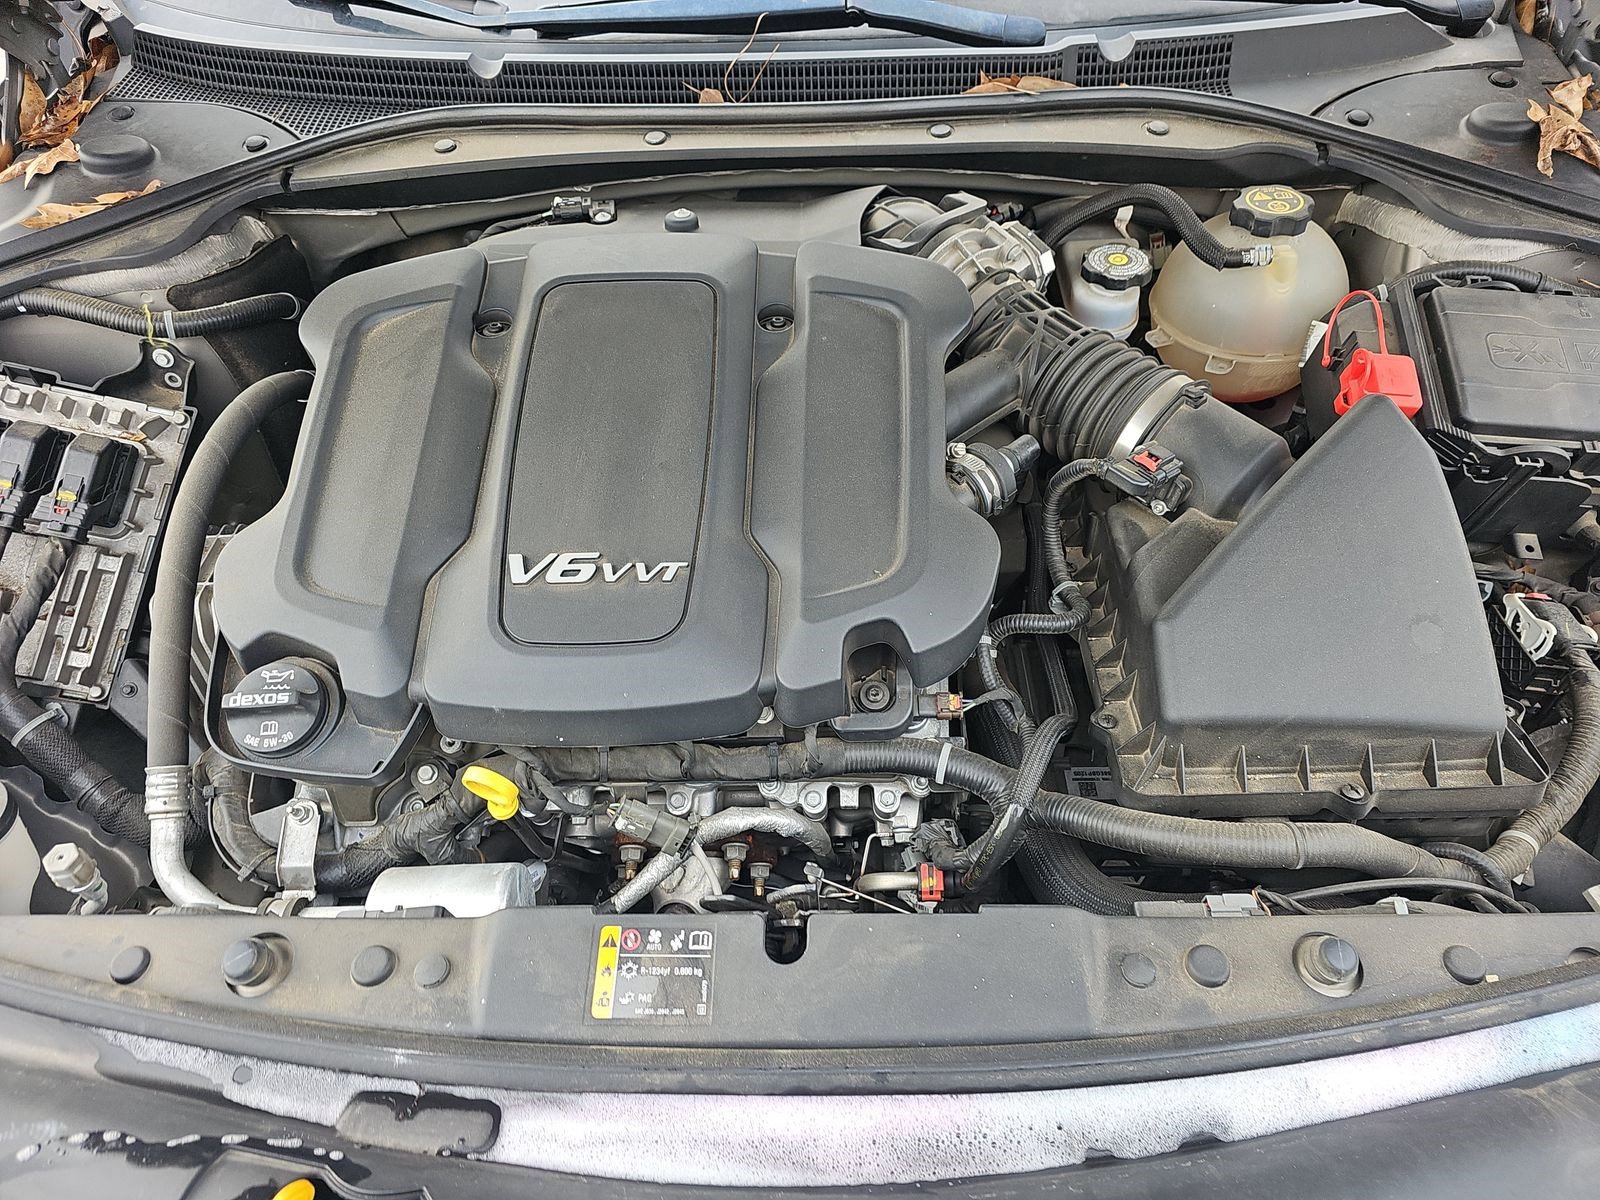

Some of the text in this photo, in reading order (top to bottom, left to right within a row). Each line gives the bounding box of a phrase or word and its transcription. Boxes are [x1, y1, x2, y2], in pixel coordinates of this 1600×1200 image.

[508, 552, 689, 584] V6 VVT
[229, 692, 291, 707] dexos
[244, 734, 259, 747] SAE
[646, 943, 662, 951] AUTO
[640, 966, 671, 977] R-1234yf
[693, 966, 703, 978] kg
[638, 993, 652, 1003] PAG
